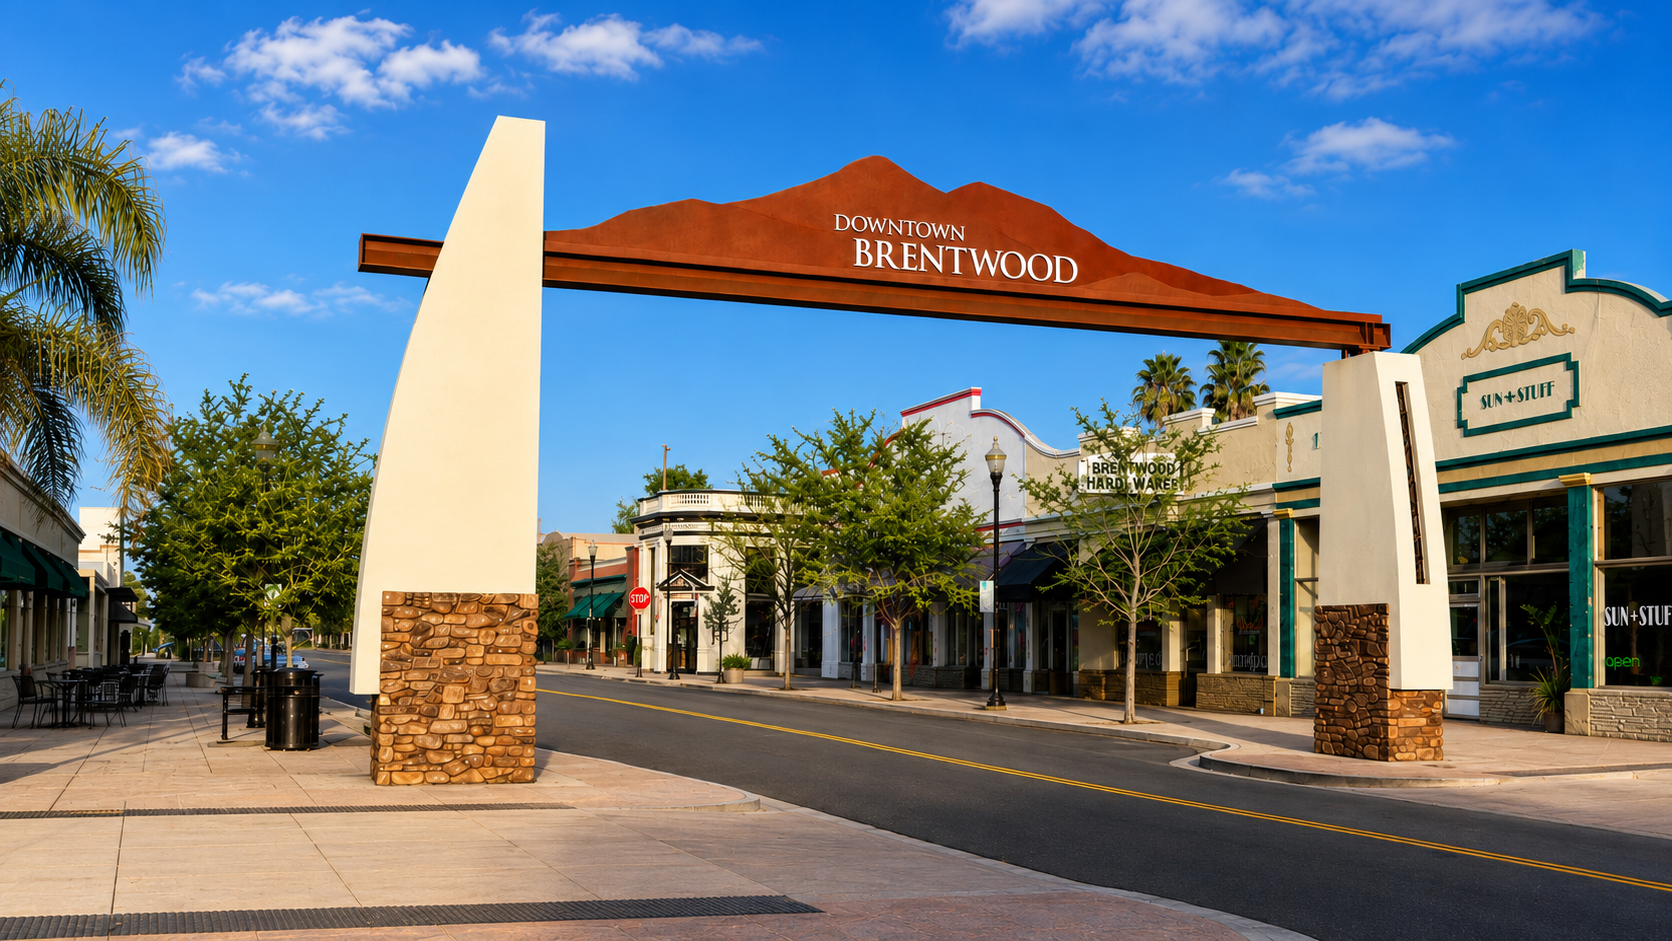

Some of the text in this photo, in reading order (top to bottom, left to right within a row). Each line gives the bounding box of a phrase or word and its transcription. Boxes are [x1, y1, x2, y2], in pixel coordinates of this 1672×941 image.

[834, 213, 966, 242] DOWNTOWN
[853, 237, 1079, 284] BRENTWOOD
[1092, 461, 1176, 476] BRENTWOOD
[630, 593, 649, 604] STOP
[1605, 656, 1641, 671] open
